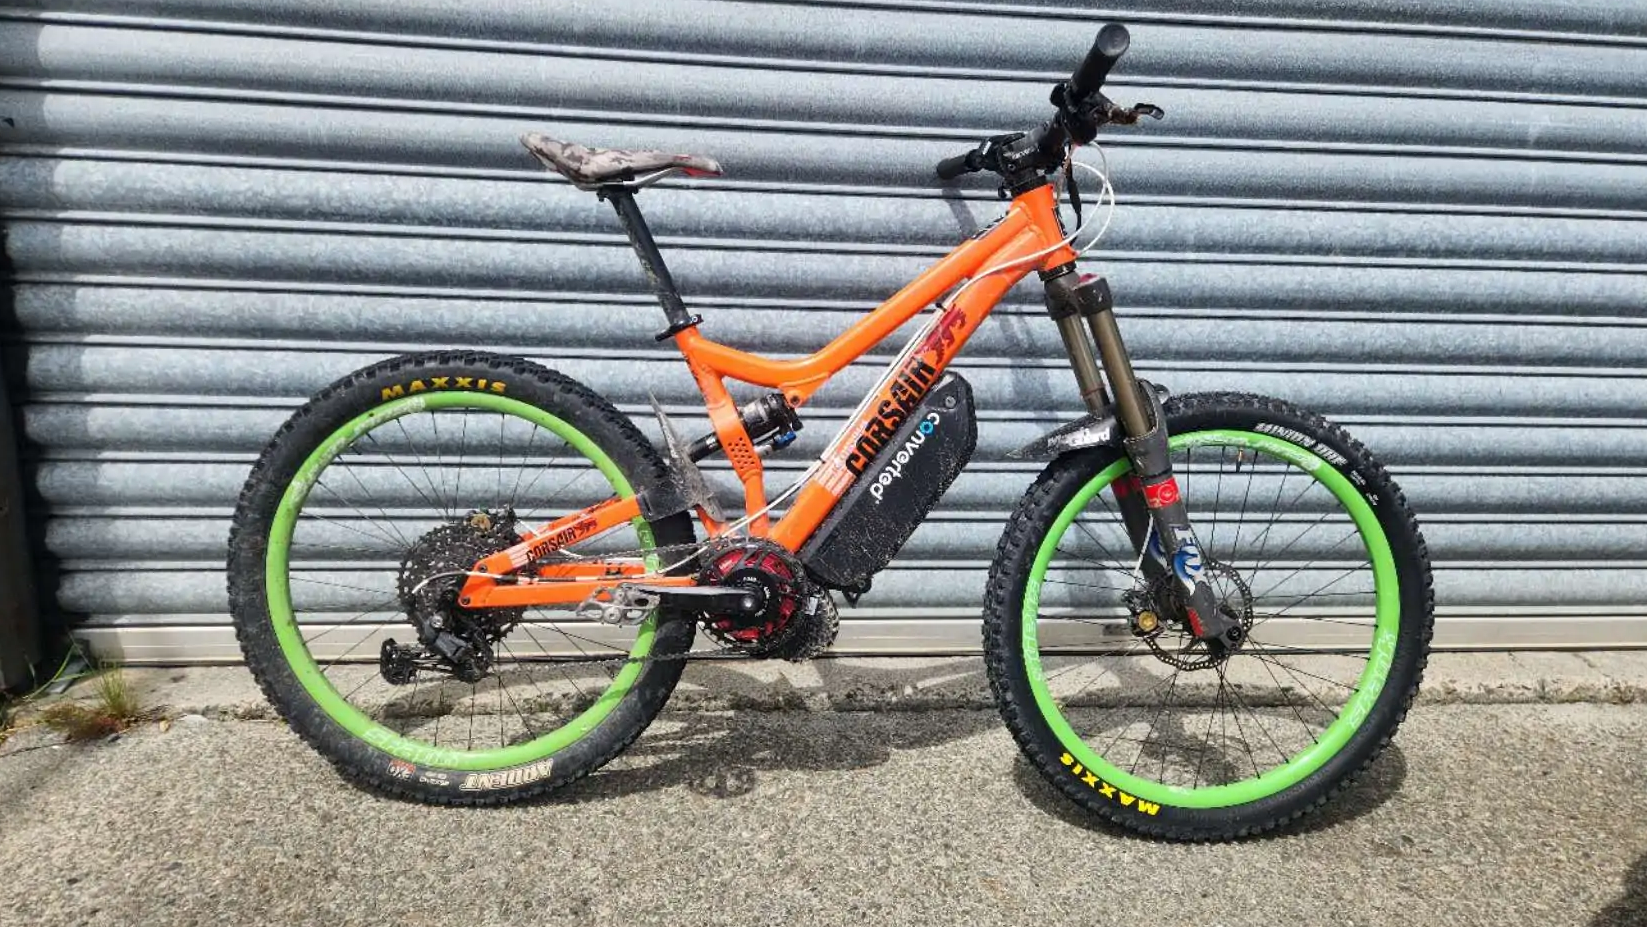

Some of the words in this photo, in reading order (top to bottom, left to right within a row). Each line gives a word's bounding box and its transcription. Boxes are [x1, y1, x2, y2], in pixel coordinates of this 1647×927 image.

[381, 376, 506, 401] MAXXIS
[845, 356, 936, 478] CORSAIR
[869, 412, 940, 502] converted
[526, 527, 577, 561] CORSAIR
[1060, 752, 1160, 816] MAXXIS
